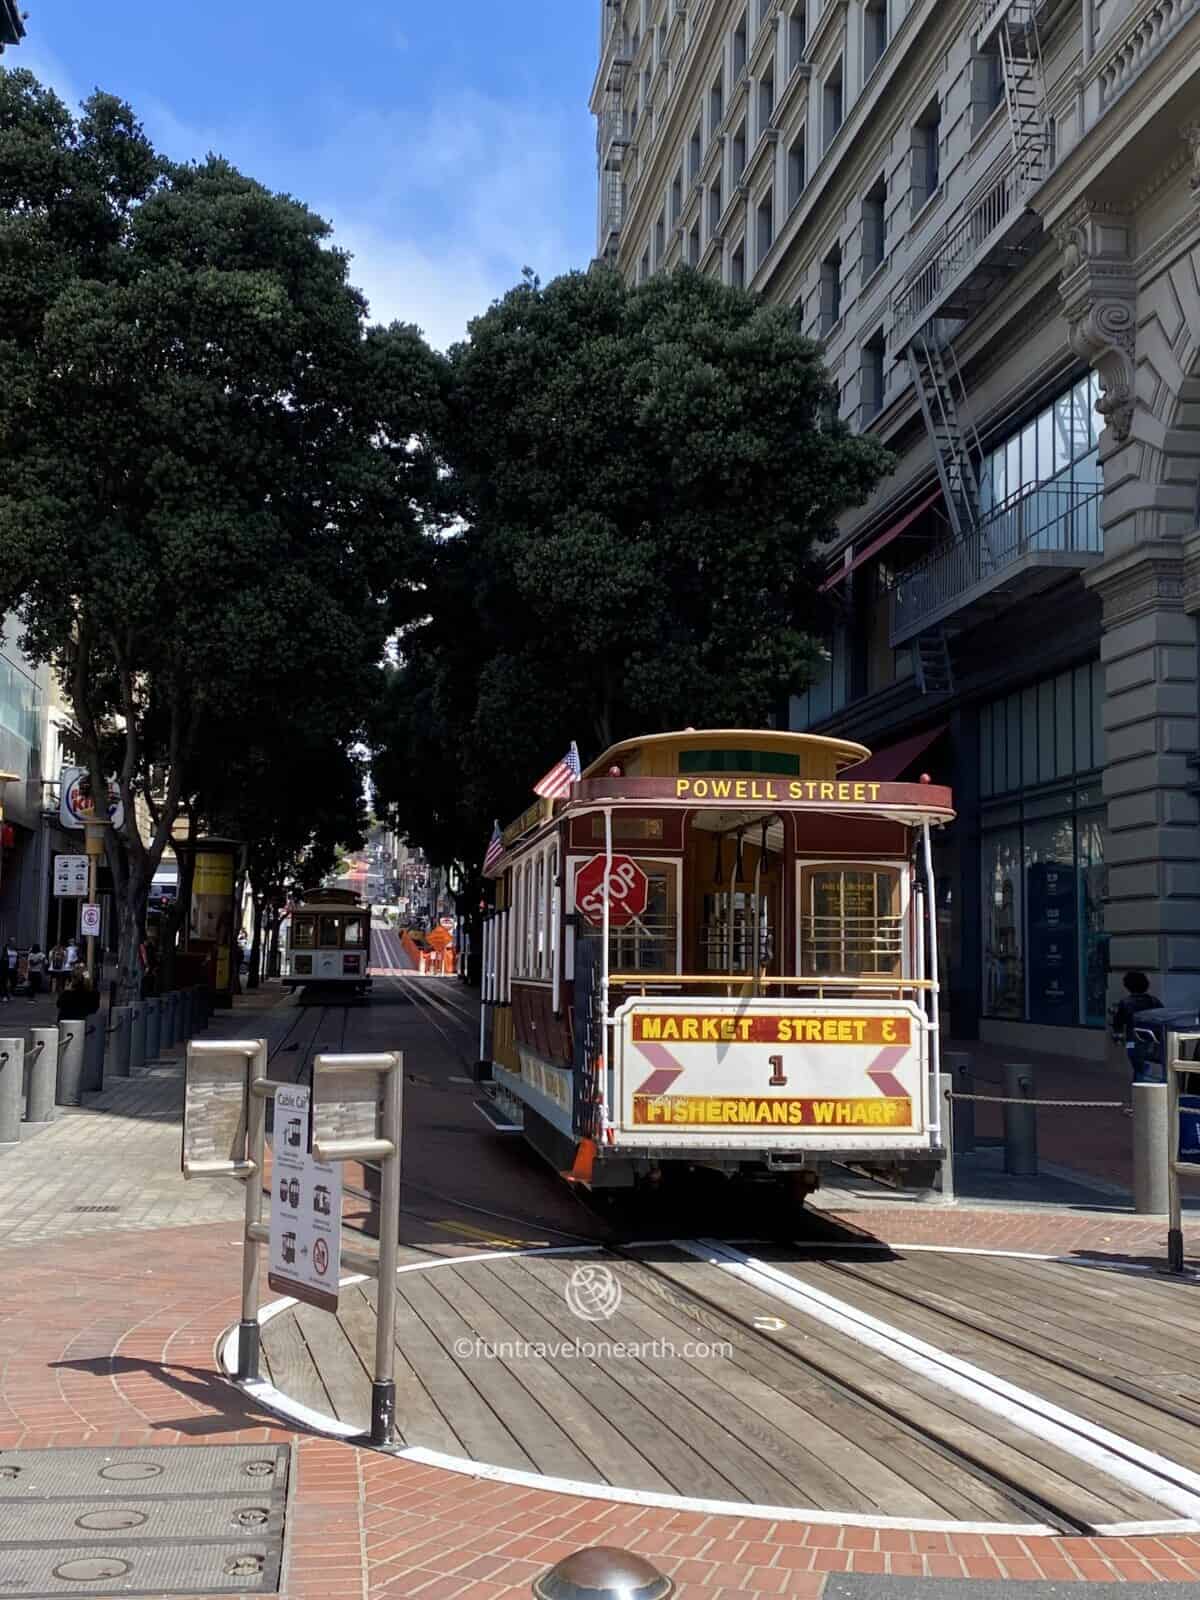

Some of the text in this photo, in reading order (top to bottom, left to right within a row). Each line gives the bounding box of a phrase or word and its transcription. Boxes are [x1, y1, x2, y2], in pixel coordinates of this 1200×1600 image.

[676, 778, 881, 802] POWELL STREET
[582, 862, 636, 920] STOP
[642, 1017, 753, 1040] MARKET
[777, 1018, 869, 1041] STREET
[768, 1054, 788, 1087] 1
[647, 1100, 899, 1124] FISHERMANS WHARF
